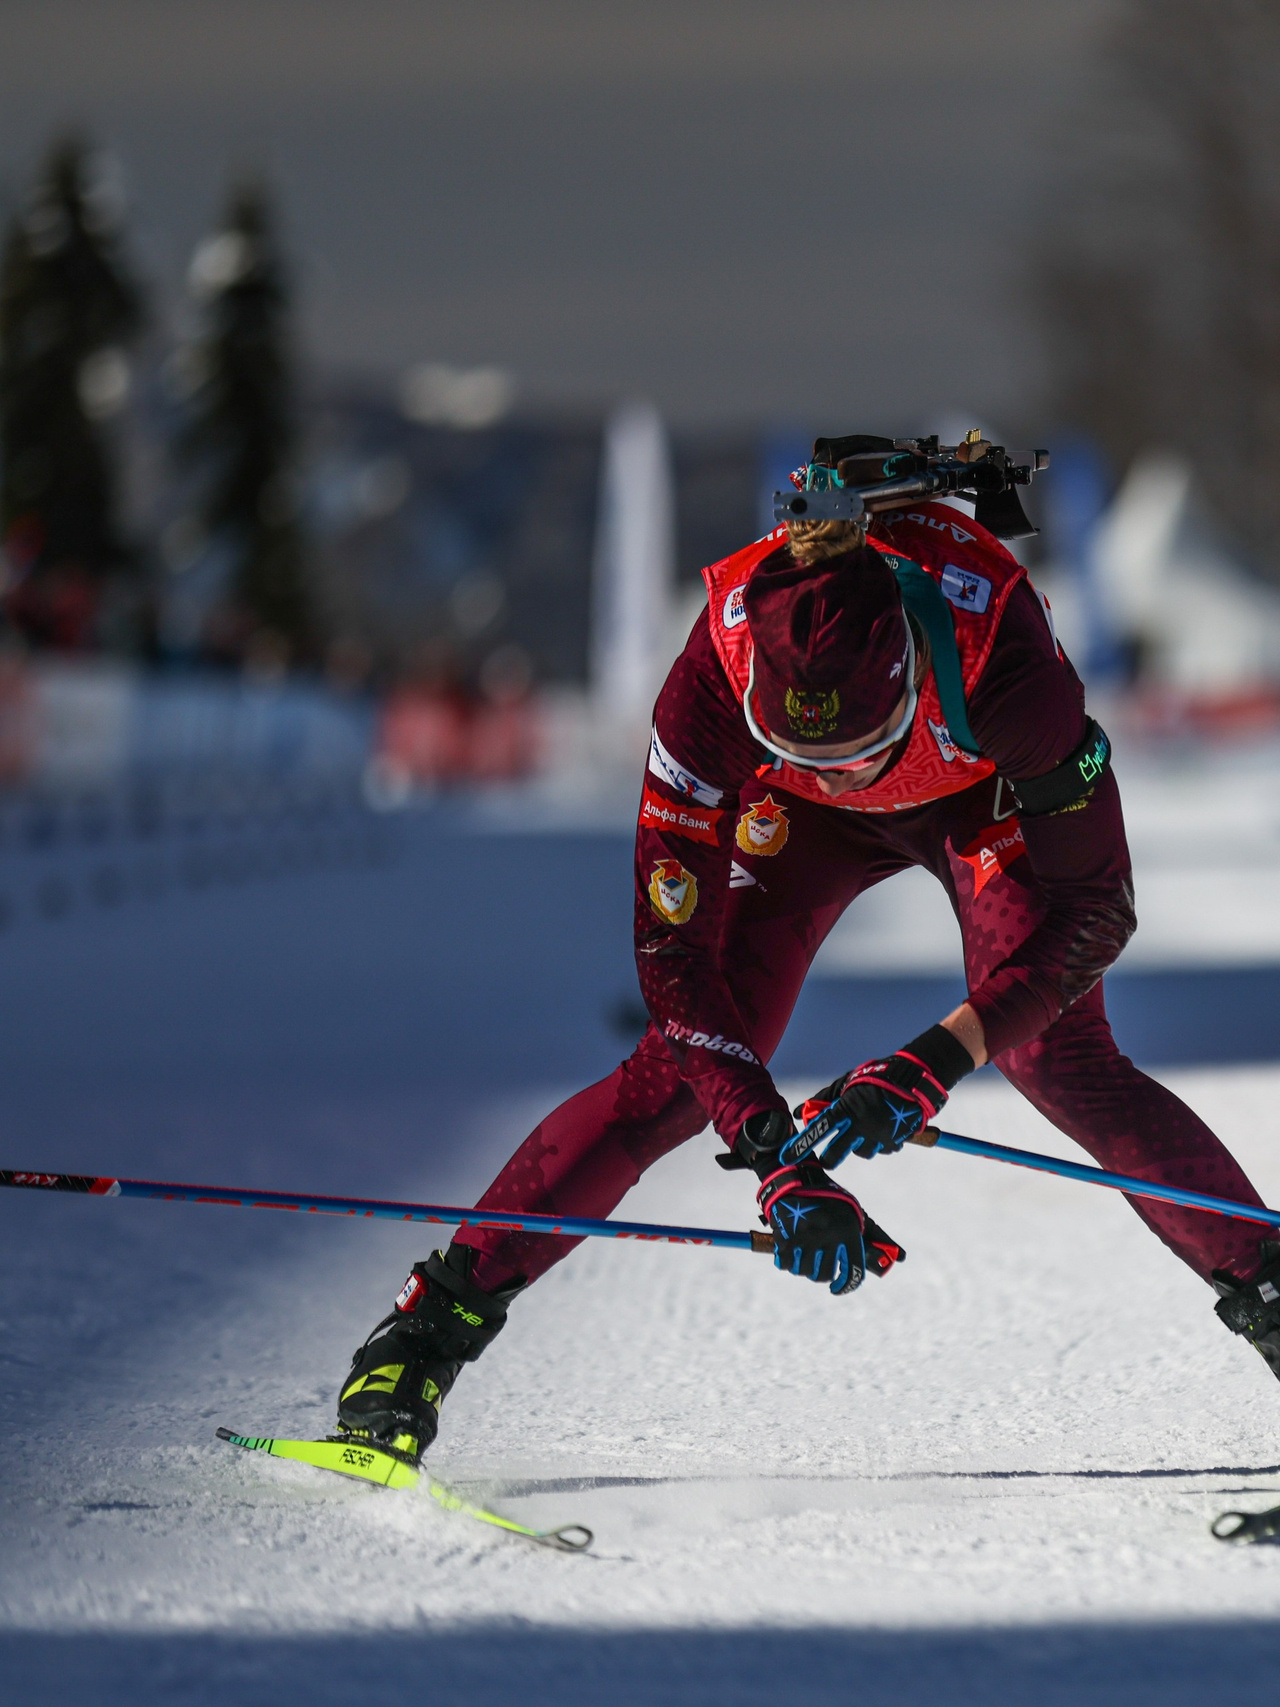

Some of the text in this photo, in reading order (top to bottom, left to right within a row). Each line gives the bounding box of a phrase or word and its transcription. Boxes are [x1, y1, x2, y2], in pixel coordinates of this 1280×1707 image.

[644, 800, 711, 830] Альфа Банк
[751, 825, 770, 840] ЦСКА
[661, 888, 681, 905] ЦСКА
[795, 1120, 828, 1155] KV+
[339, 1448, 375, 1470] FISCHER
